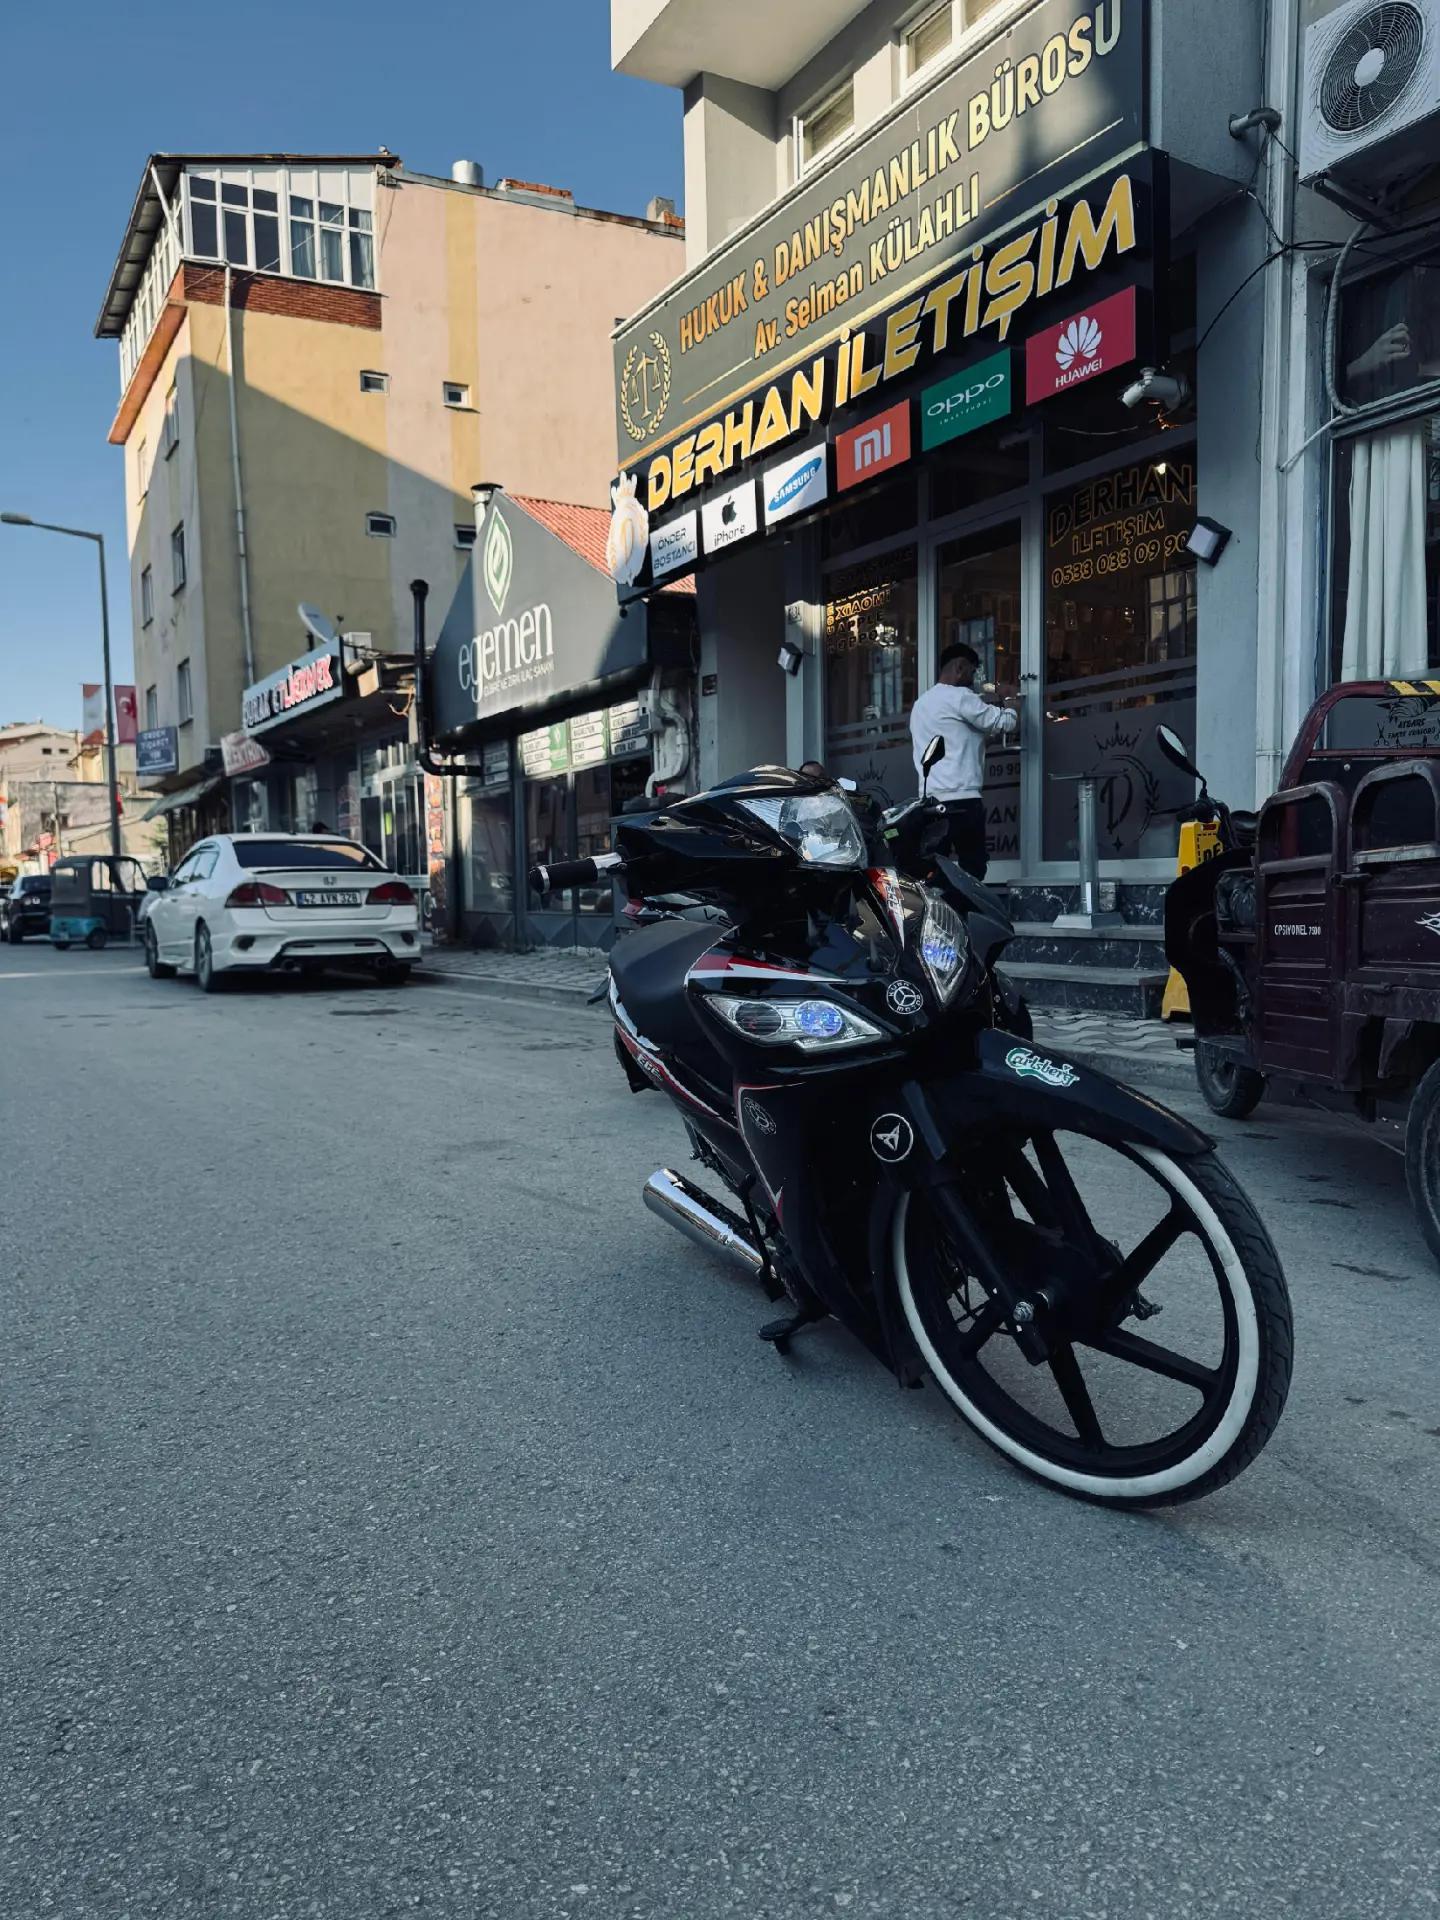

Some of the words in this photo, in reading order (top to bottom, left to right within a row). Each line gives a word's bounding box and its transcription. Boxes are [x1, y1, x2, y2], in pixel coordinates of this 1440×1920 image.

[680, 270, 748, 354] HUKUK
[752, 258, 770, 303] &
[774, 109, 961, 289] DANIŞMANLIK
[967, 0, 1121, 152] BÜROSU
[753, 317, 783, 360] Av.
[784, 260, 865, 338] Selman
[869, 171, 980, 285] KÜLAHLI
[648, 356, 825, 513] DERHAN
[835, 174, 1136, 408] İLETİŞİM
[1055, 358, 1103, 388] HUAWEI
[772, 466, 816, 503] SAMSUNG
[1050, 463, 1192, 548] DERHAN
[713, 524, 746, 548] iPhone
[1051, 559, 1093, 588] 0533
[1096, 548, 1131, 575] 033
[1134, 540, 1160, 564] 09
[458, 603, 553, 703] egemen
[1005, 1048, 1079, 1086] Carlsberg
